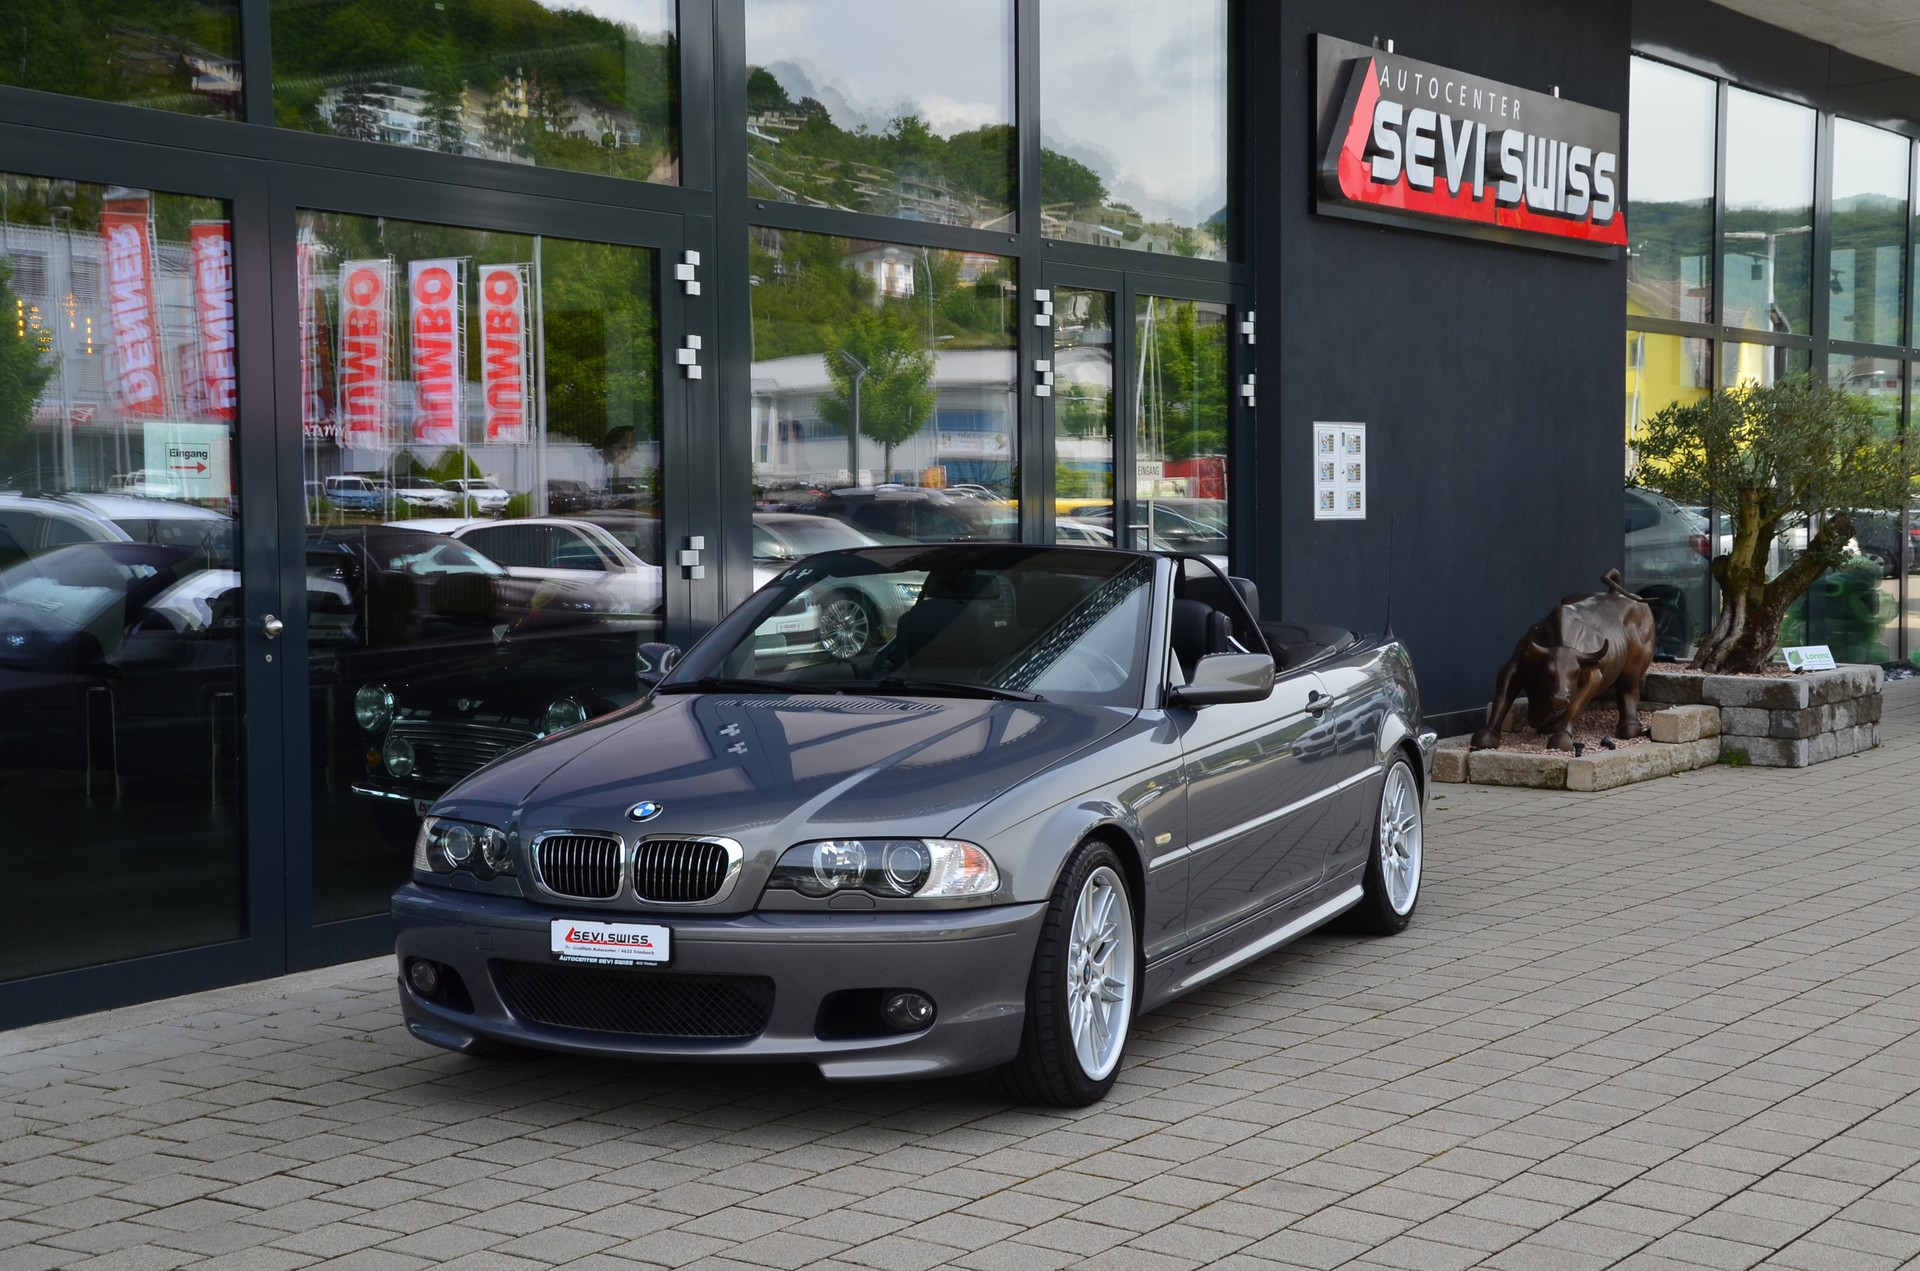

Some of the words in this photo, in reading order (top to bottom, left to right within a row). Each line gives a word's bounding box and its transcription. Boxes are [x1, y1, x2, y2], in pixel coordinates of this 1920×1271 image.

[1379, 65, 1521, 120] AUTOCENTER
[1371, 100, 1487, 198] SEVI
[1497, 128, 1616, 221] SWISS
[169, 448, 208, 460] Eingang
[1137, 465, 1160, 476] EINGANG
[573, 931, 604, 942] SEVI
[608, 934, 648, 944] SWISS
